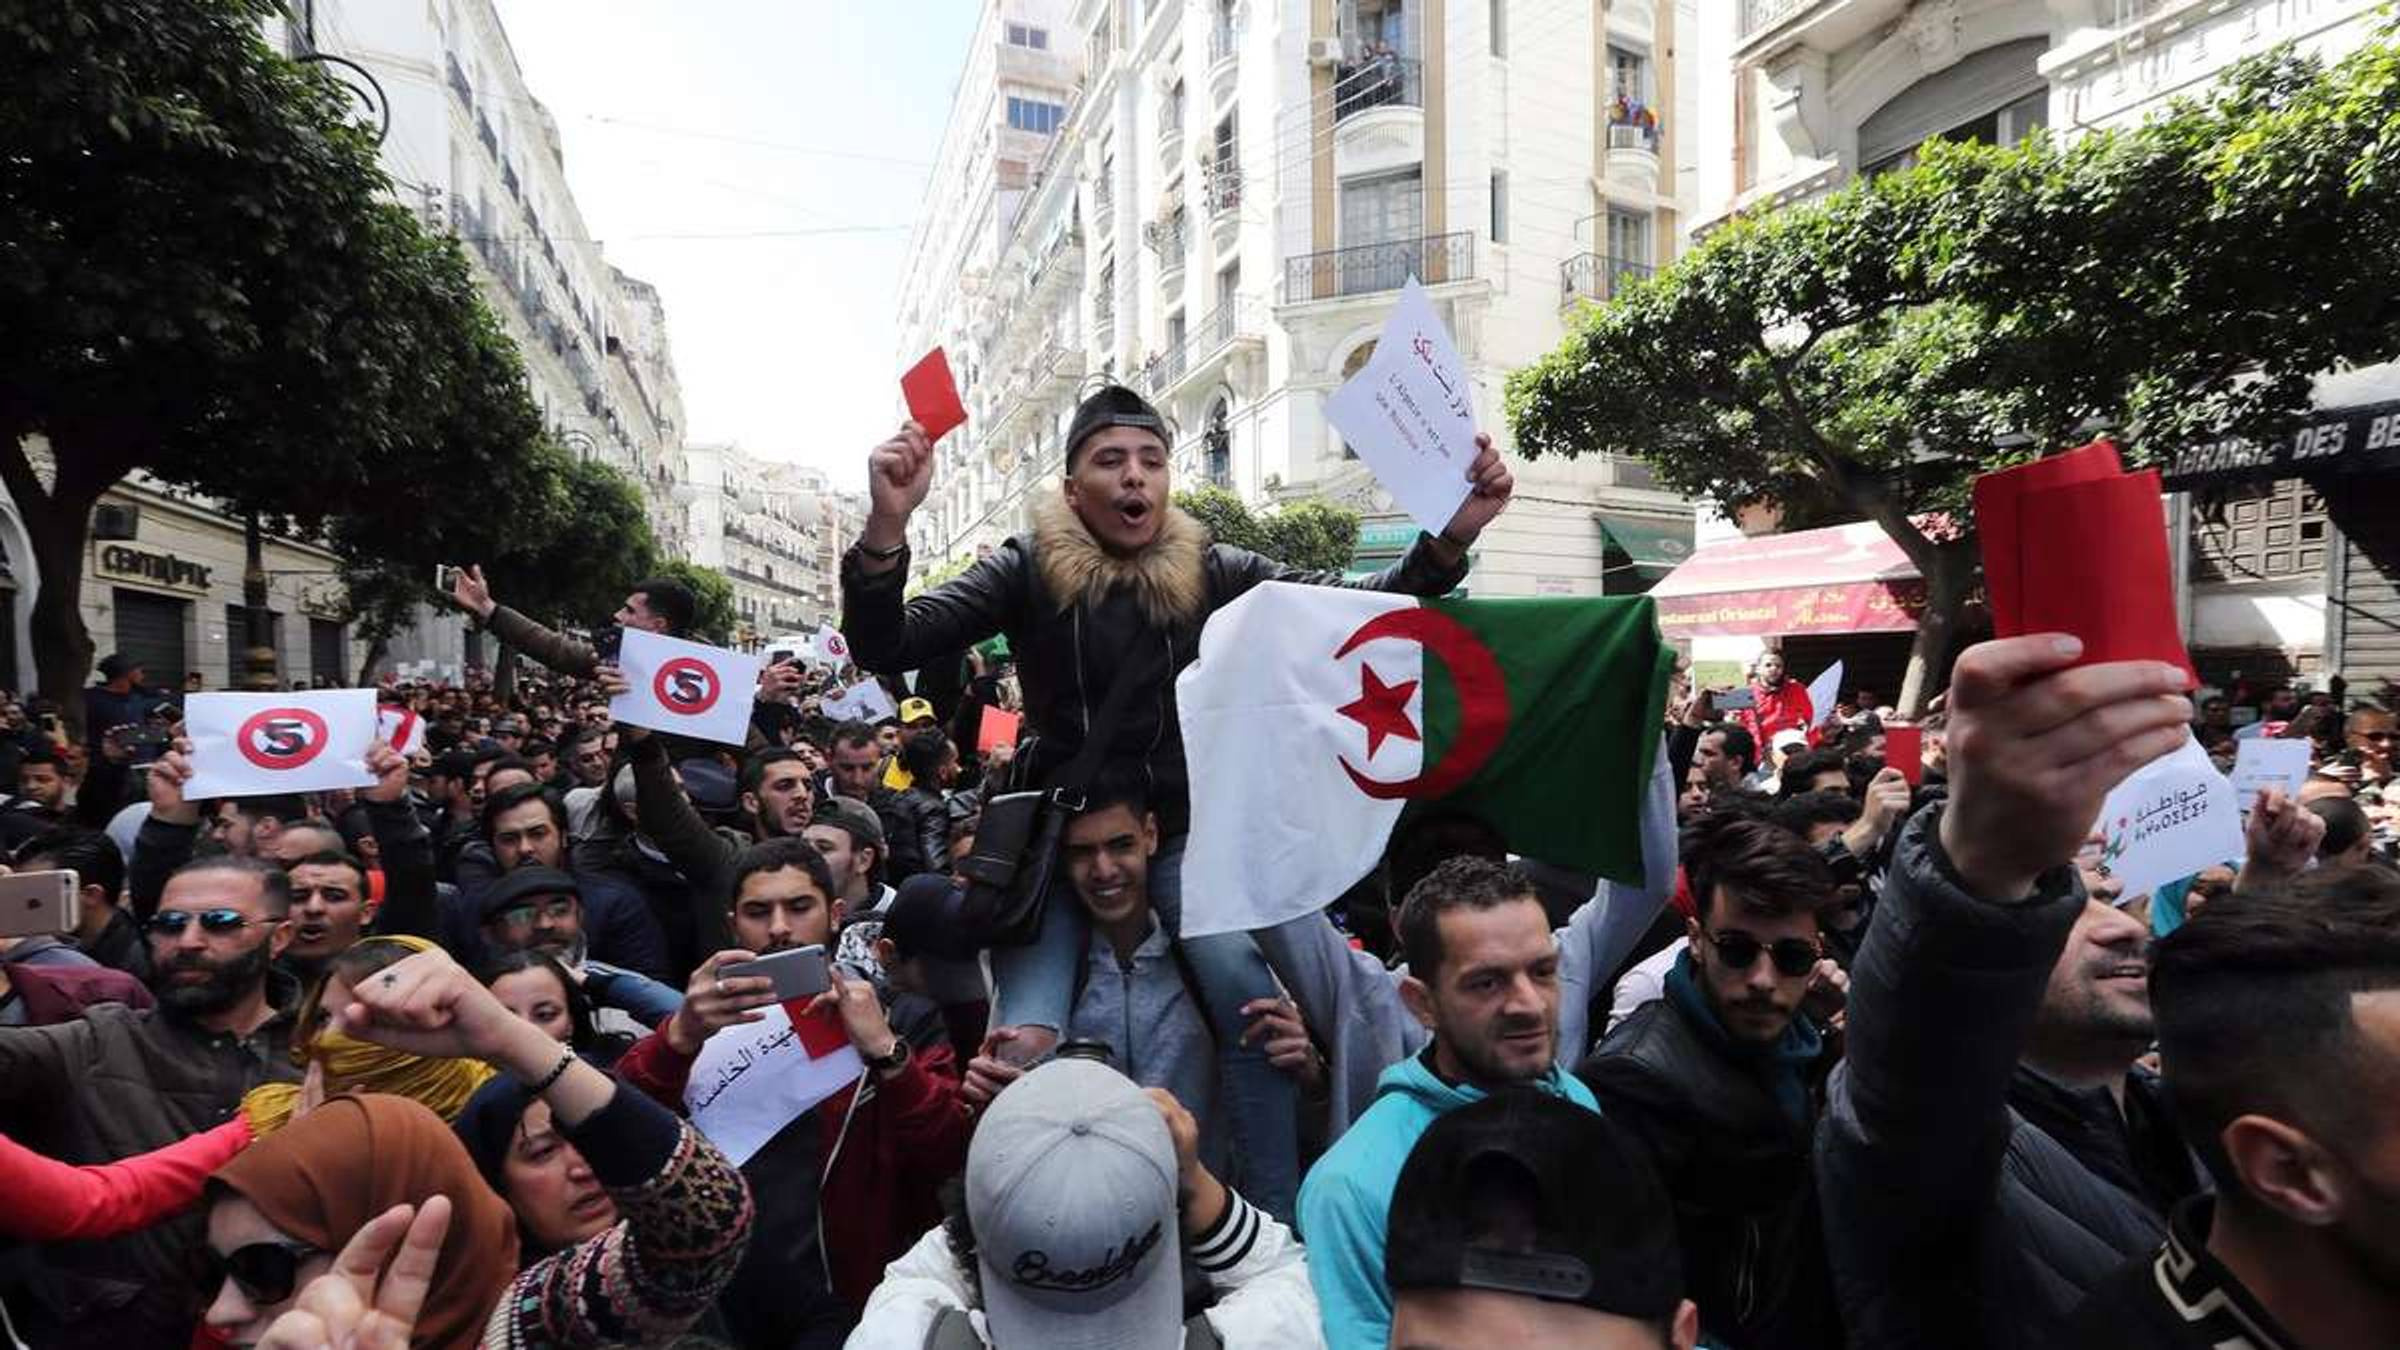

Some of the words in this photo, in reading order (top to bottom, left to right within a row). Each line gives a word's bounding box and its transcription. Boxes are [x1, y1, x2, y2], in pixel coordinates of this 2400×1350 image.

[2292, 422, 2349, 461] DES
[1719, 606, 1777, 623] Oriental
[672, 669, 703, 704] 5
[264, 722, 306, 755] 5
